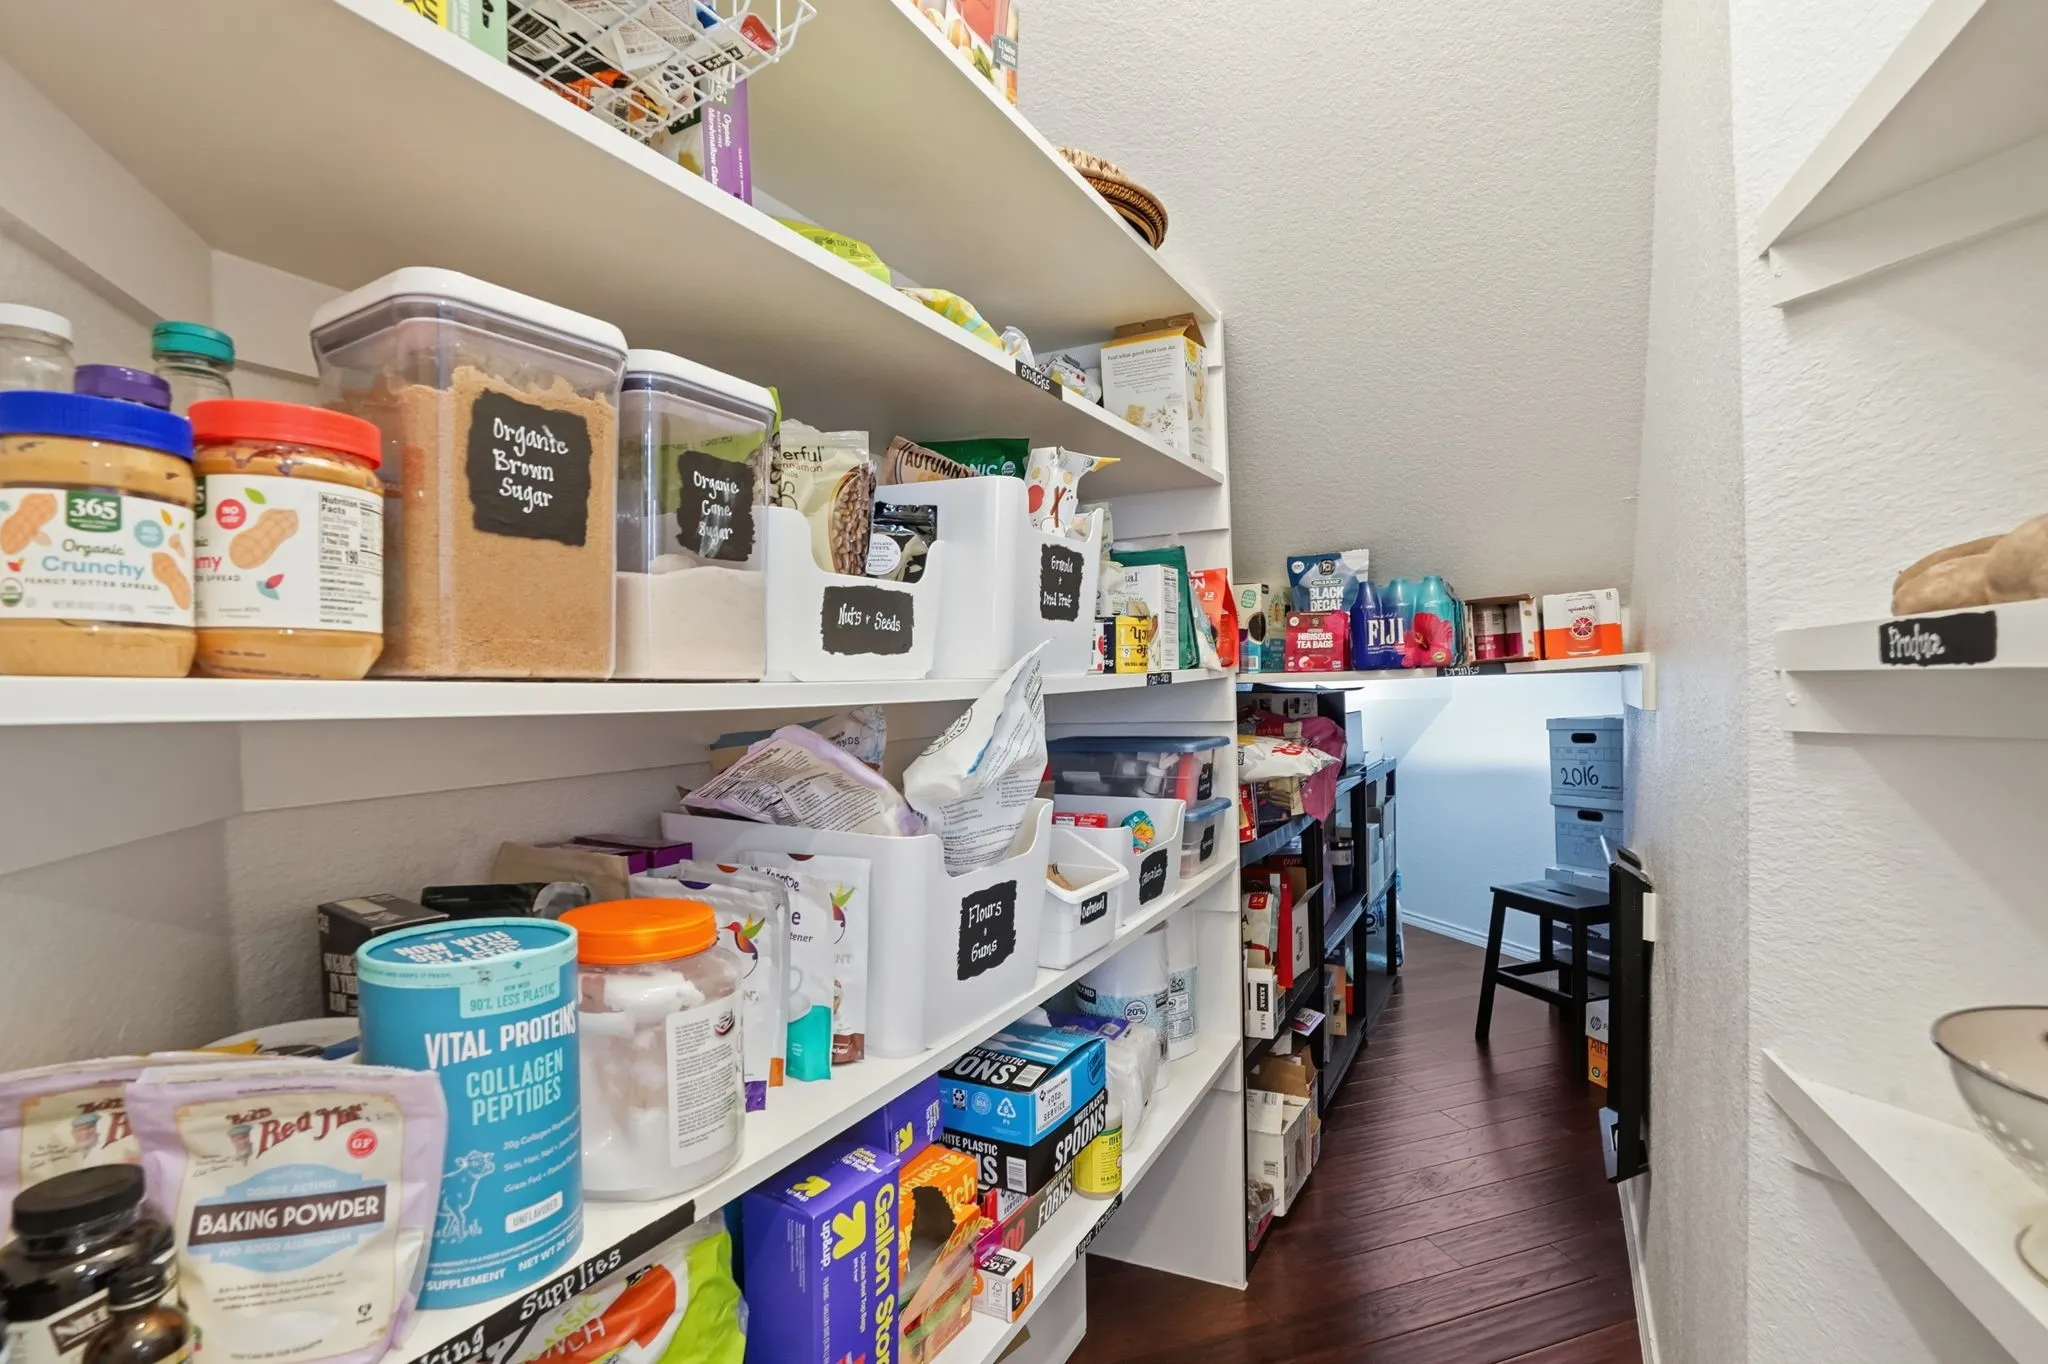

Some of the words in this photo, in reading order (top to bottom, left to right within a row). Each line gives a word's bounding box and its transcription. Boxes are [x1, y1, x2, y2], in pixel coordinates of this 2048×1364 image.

[1021, 364, 1050, 390] Snacks
[493, 417, 569, 457] Organic
[493, 449, 554, 481] Brown
[782, 446, 822, 462] erful
[782, 462, 823, 472] nnamon
[968, 463, 998, 476] NIC
[499, 478, 553, 513] Sugar
[693, 471, 739, 499] Organic
[69, 498, 118, 520] 365
[321, 495, 358, 510] Nutrition
[321, 504, 346, 516] Facts
[702, 500, 732, 516] Cane
[62, 538, 125, 557] Organic
[345, 550, 359, 565] 190
[41, 555, 145, 581] Crunchy
[207, 574, 241, 583] SPREAD
[1125, 571, 1138, 582] ial
[1309, 586, 1344, 600] BLACK
[1310, 599, 1343, 611] DECAF
[838, 603, 862, 626] Nuts
[874, 610, 901, 632] Seeds
[1297, 632, 1333, 641] HIBISCUS
[1367, 617, 1405, 647] FIJI
[1296, 640, 1311, 649] TEA
[1312, 640, 1333, 649] BAGS
[1444, 665, 1479, 676] Drinks
[1561, 765, 1599, 787] 2016
[968, 900, 1002, 925] Flours
[393, 942, 446, 957] NOW
[450, 930, 510, 947] WITH
[790, 932, 813, 943] tener
[971, 940, 998, 962] Gums
[470, 998, 493, 1012] 90%
[497, 993, 521, 1009] LESS
[522, 982, 556, 1001] PLASTIC
[503, 984, 518, 992] NOW
[1078, 986, 1095, 998] LAND
[1127, 1006, 1146, 1017] 20%
[424, 1029, 492, 1070] VITAL
[499, 1001, 577, 1052] PROTEINS
[987, 1050, 1026, 1066] PLASTIC
[466, 1047, 563, 1099] COLLAGEN
[954, 1056, 1017, 1085] ONS
[472, 1075, 562, 1126] PEPTIDES
[1003, 1106, 1010, 1114] 6
[1043, 1101, 1066, 1122] SERVICE
[256, 1113, 313, 1159] Red
[314, 1102, 364, 1141] Mill
[1054, 1103, 1106, 1172] SPOONS
[352, 1138, 370, 1149] GF
[962, 1138, 998, 1156] PLASTIC
[291, 1180, 337, 1194] ACTING
[946, 1174, 975, 1213] ich
[512, 1198, 558, 1226] UNFLAVORED
[1037, 1172, 1072, 1230] FORKS
[196, 1207, 277, 1236] BAKING
[282, 1196, 380, 1229] POWDER
[820, 1220, 833, 1268] up&up
[874, 1183, 895, 1297] Gallon
[219, 1246, 240, 1258] NO
[426, 1268, 507, 1291] SUPPLEMENT
[518, 1257, 540, 1272] NET
[540, 1249, 556, 1262] WT
[420, 1325, 485, 1364] king
[519, 1249, 622, 1322] Supplies
